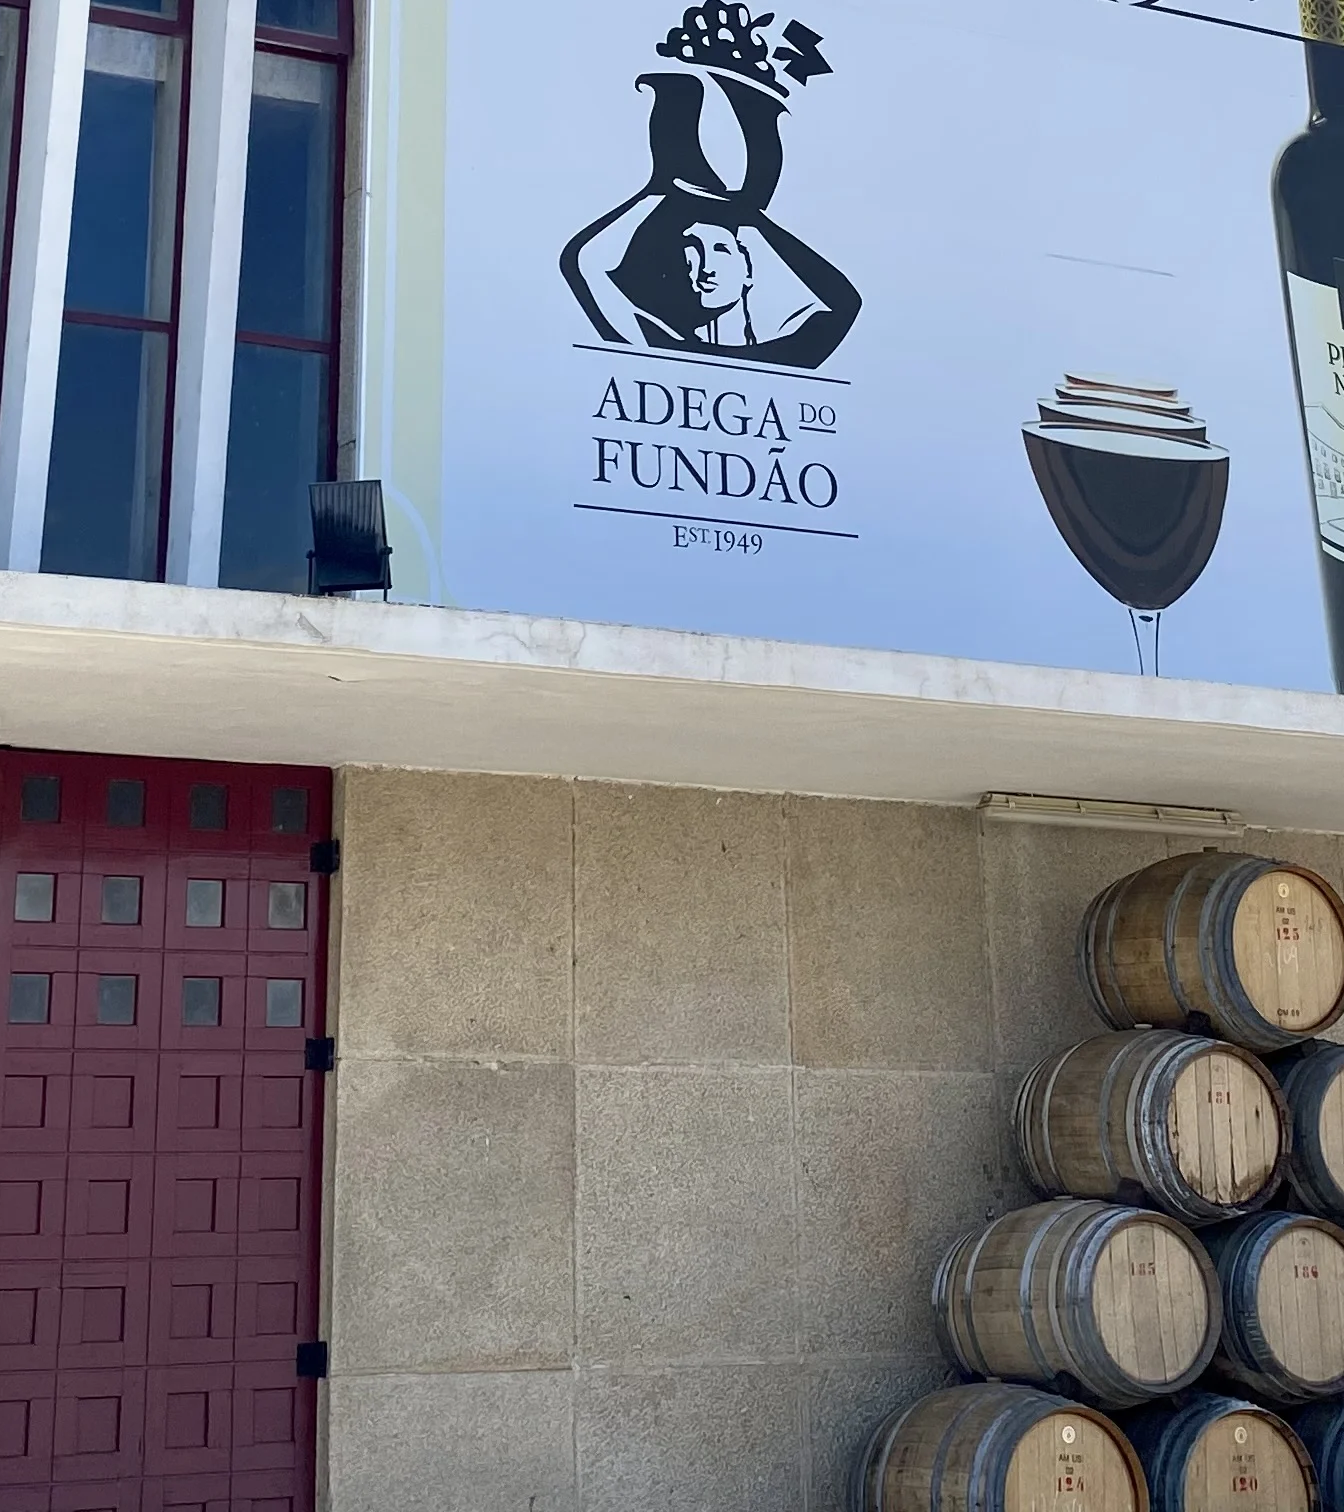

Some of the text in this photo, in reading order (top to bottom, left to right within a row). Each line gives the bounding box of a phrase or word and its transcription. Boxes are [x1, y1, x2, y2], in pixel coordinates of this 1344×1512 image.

[592, 376, 837, 442] ADEGA DO
[592, 436, 838, 509] FUNDÃO
[1276, 927, 1300, 941] 125
[1058, 1476, 1084, 1492] 124
[1232, 1476, 1258, 1492] 120
